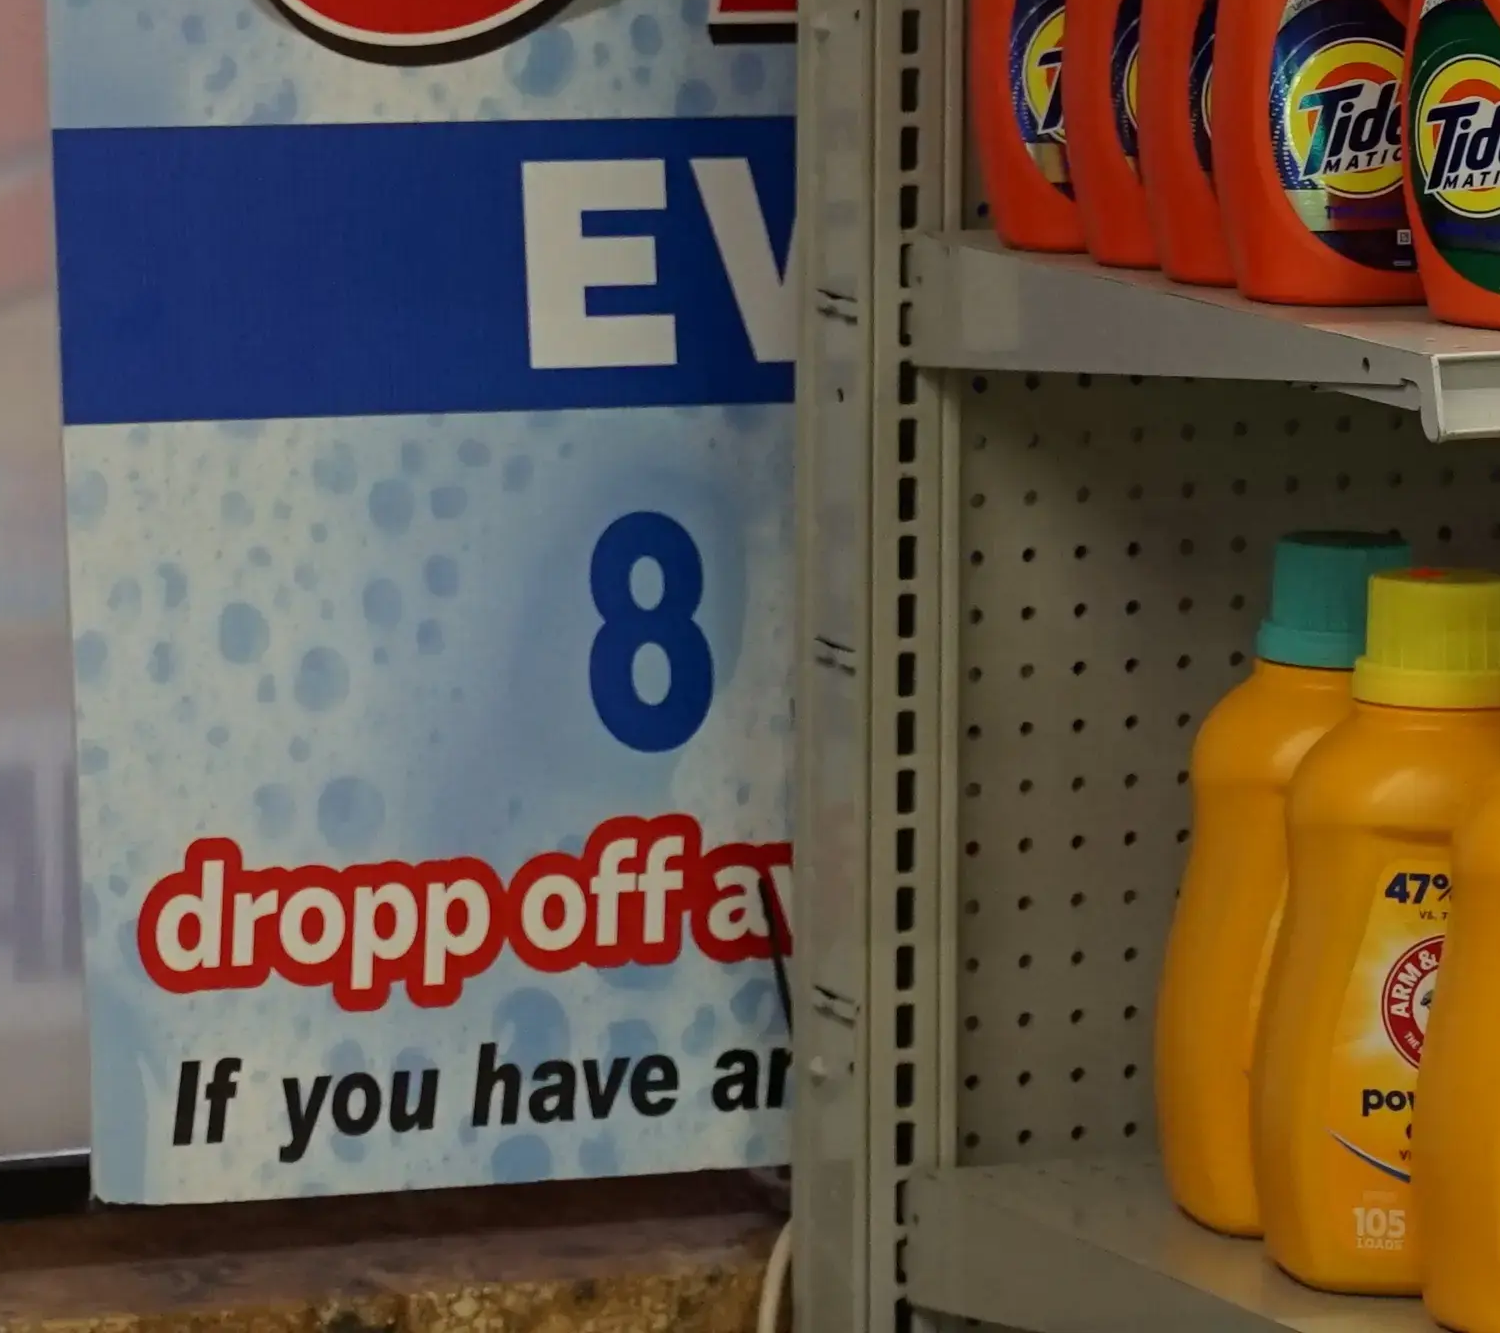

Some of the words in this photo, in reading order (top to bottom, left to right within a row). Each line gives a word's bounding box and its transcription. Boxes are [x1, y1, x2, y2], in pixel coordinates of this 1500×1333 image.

[588, 510, 715, 753] 8
[152, 857, 495, 991] dropp
[519, 836, 686, 952] off
[171, 1056, 242, 1147] If
[279, 1063, 442, 1163] you
[471, 1042, 680, 1128] have
